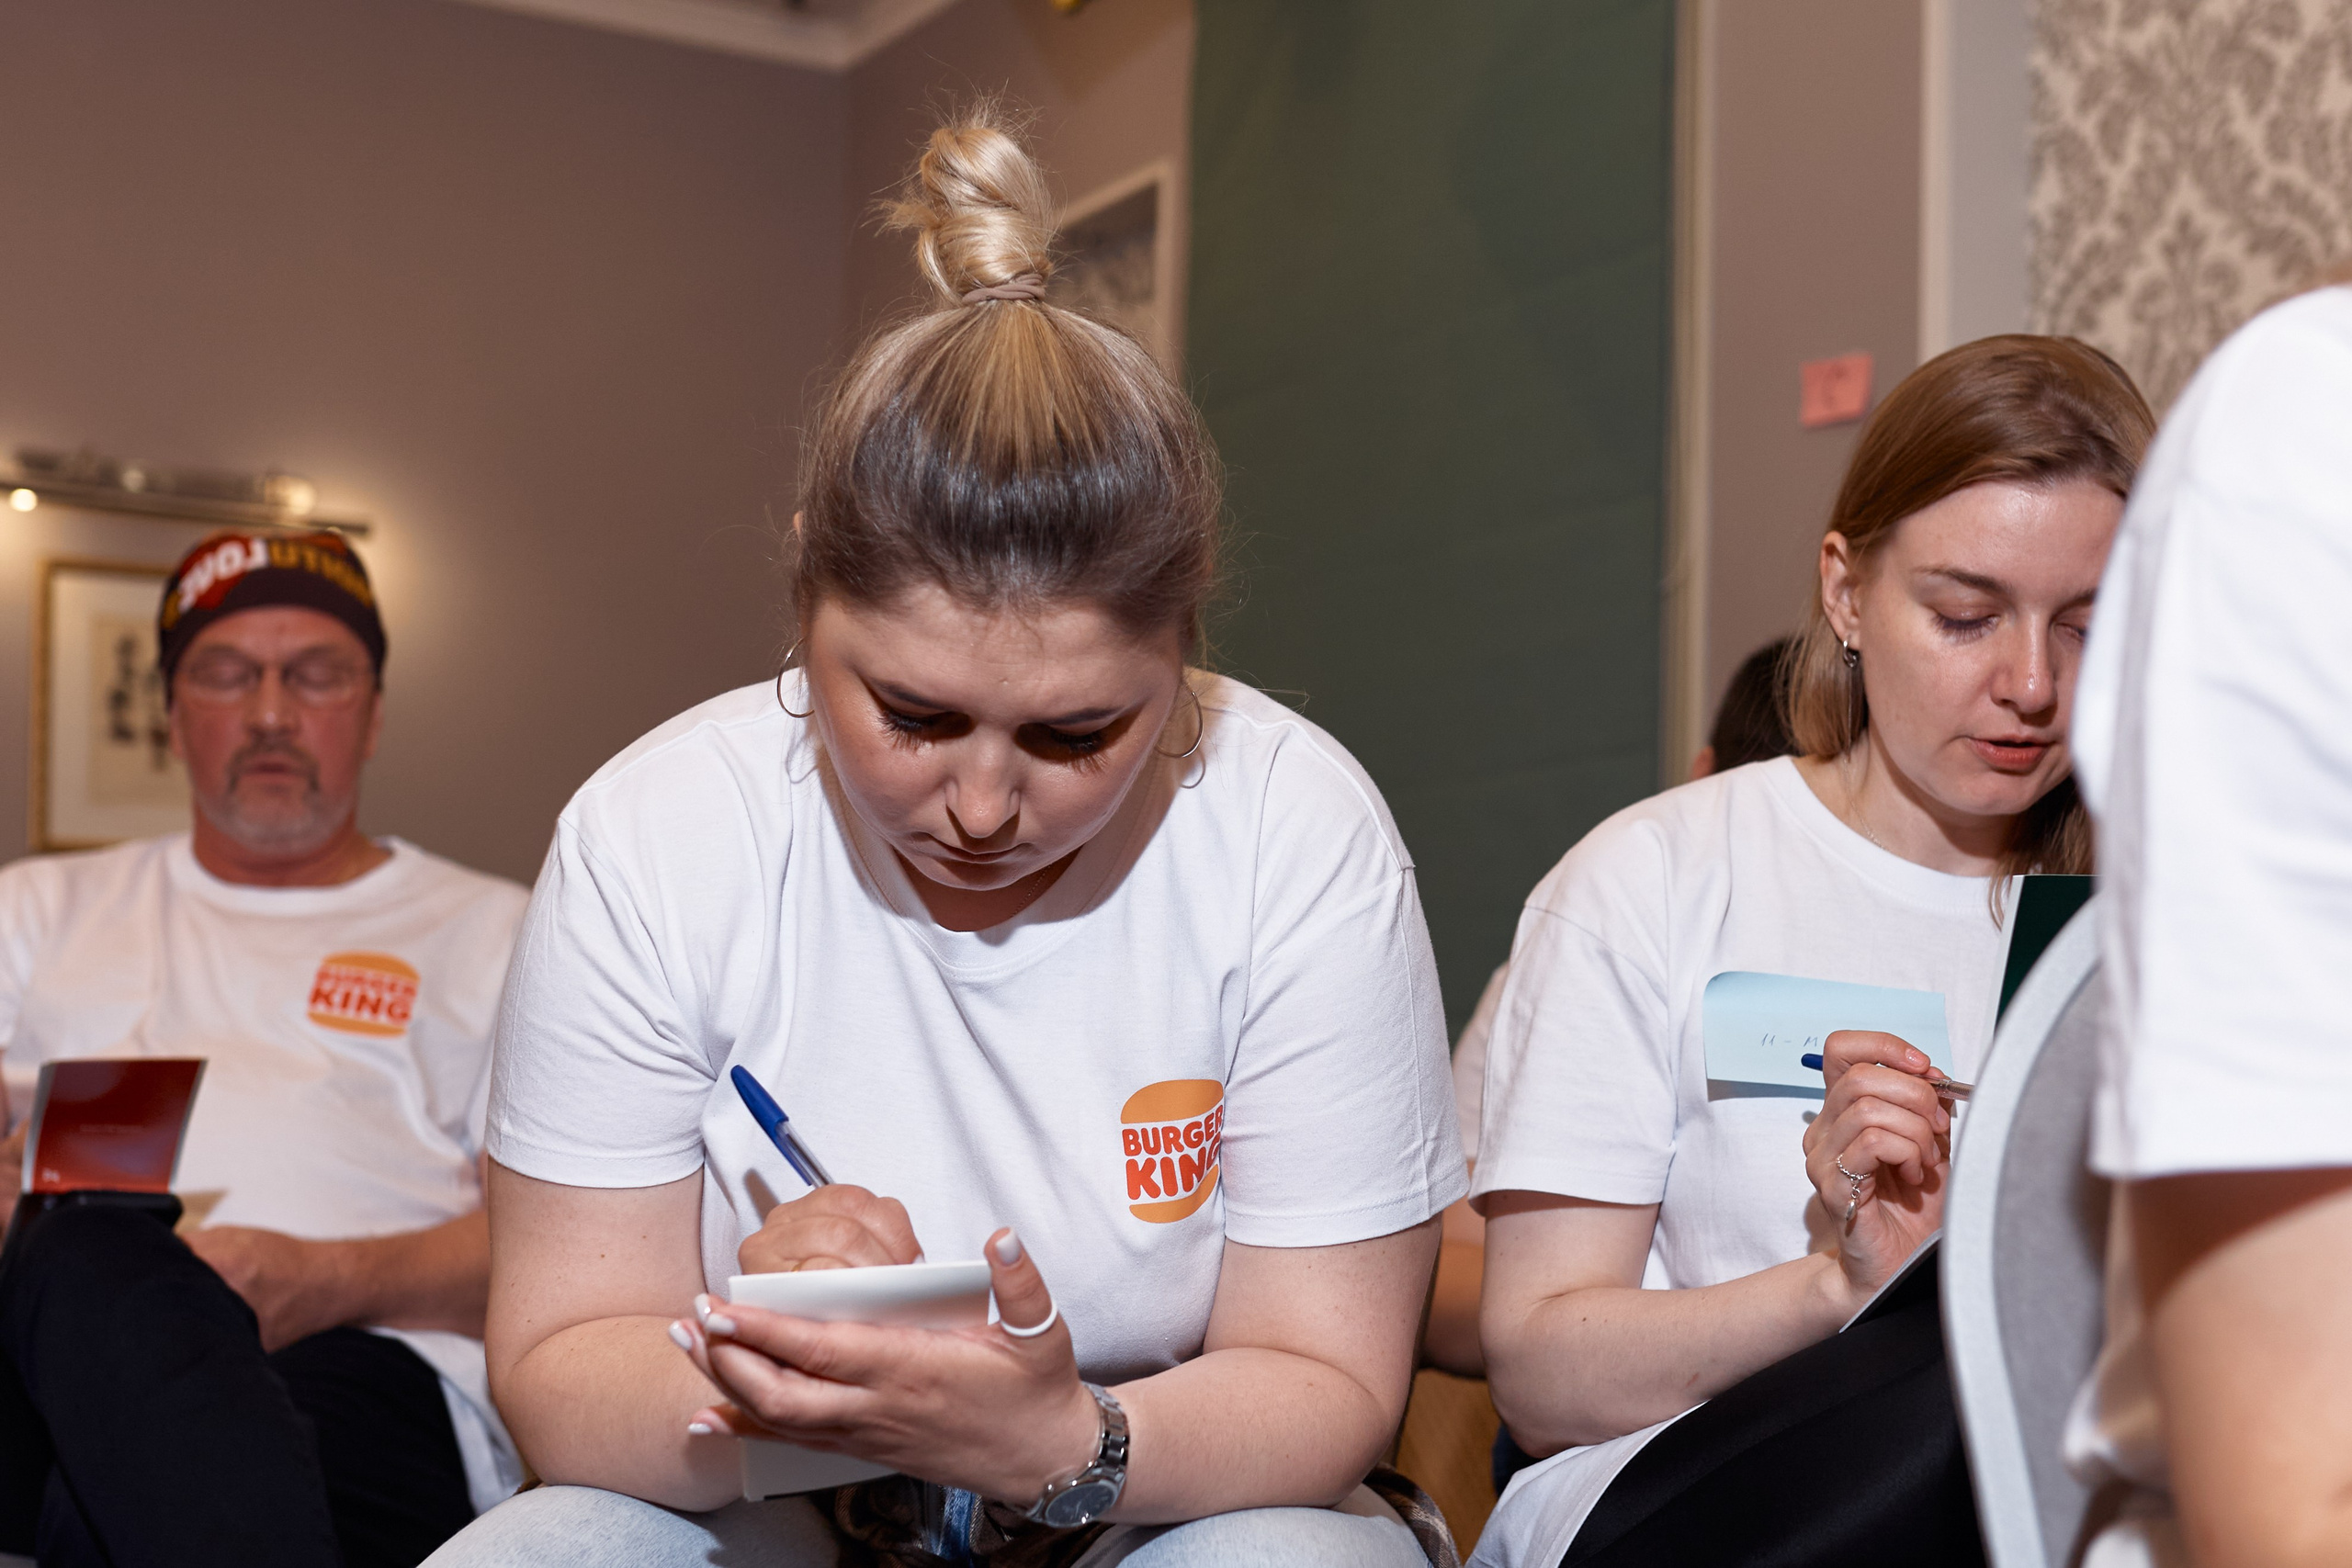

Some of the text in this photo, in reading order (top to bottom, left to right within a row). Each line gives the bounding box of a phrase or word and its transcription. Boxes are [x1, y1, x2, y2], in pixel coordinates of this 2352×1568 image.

[310, 987, 412, 1023] KING
[1122, 1104, 1224, 1156] BURGER
[1125, 1131, 1220, 1201] KING
